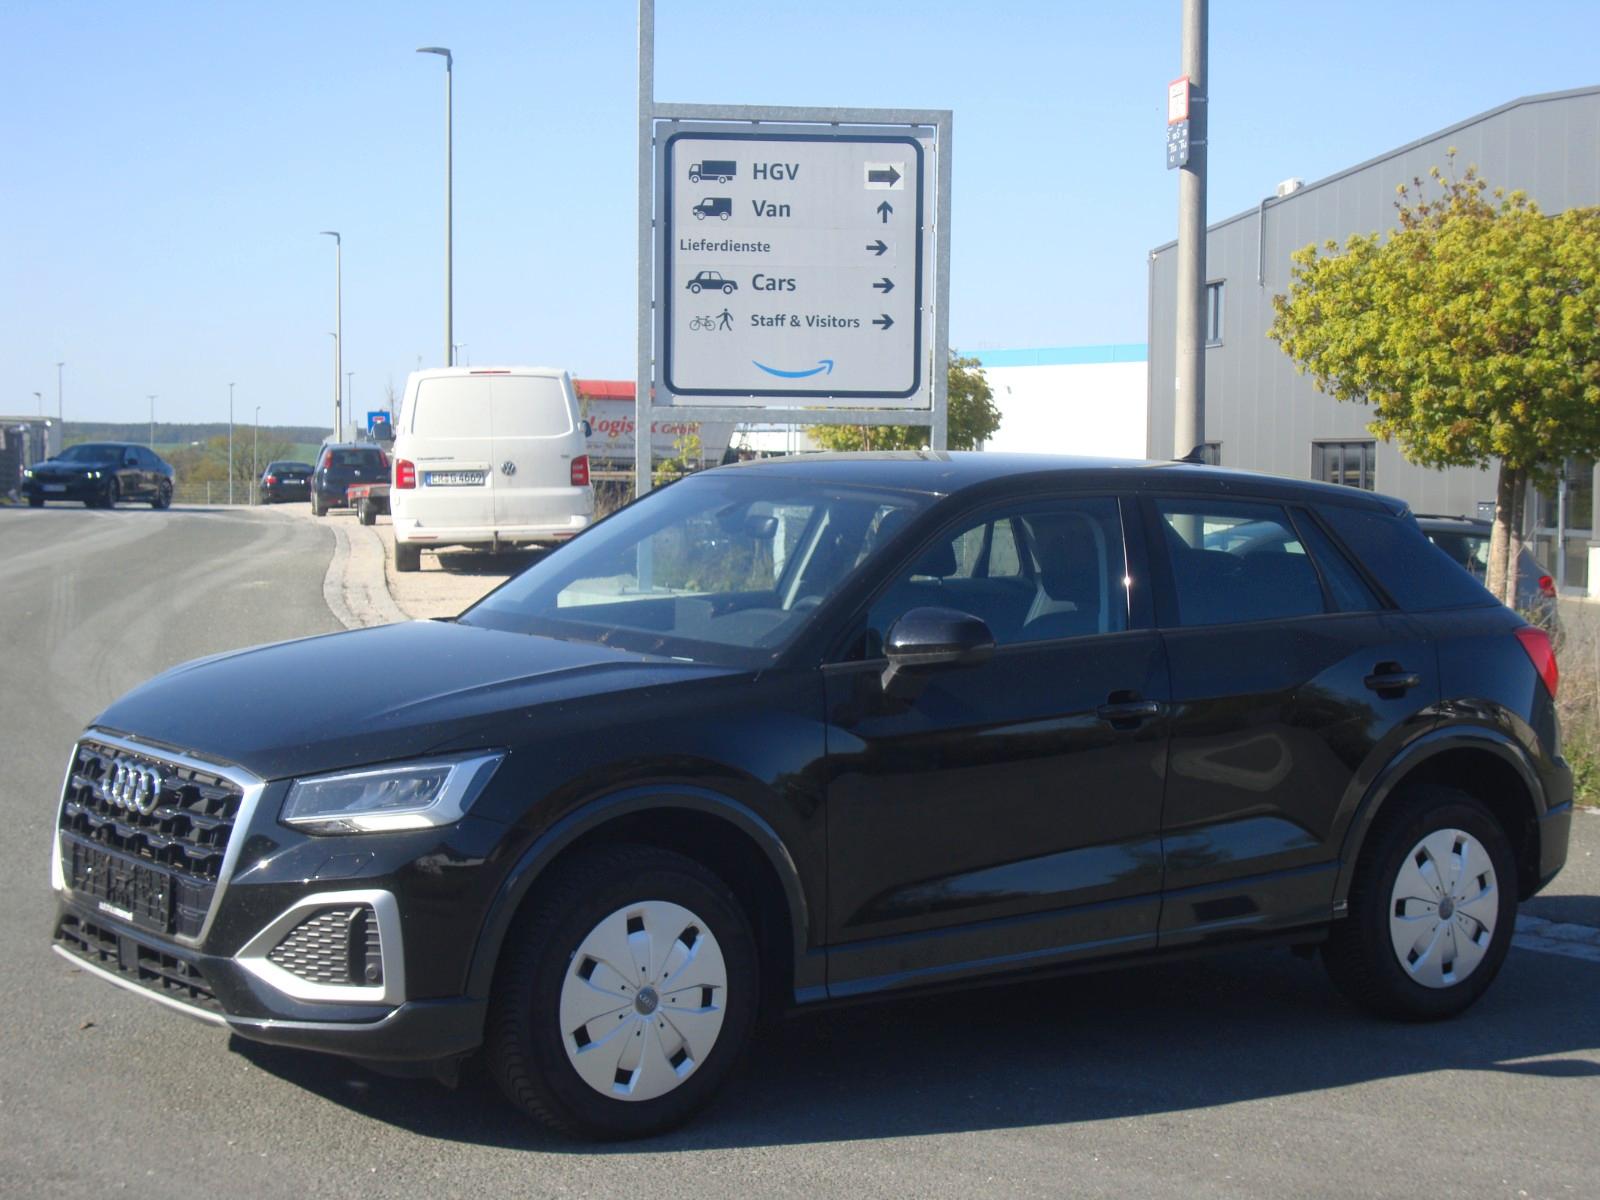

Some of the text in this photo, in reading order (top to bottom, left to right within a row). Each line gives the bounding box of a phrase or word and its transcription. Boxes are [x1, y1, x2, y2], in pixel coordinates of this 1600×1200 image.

[753, 163, 800, 181] HGV
[752, 200, 791, 218] Van
[680, 239, 771, 253] Lieferdienste
[752, 273, 797, 292] Cars
[751, 315, 861, 328] Staff & Visitors
